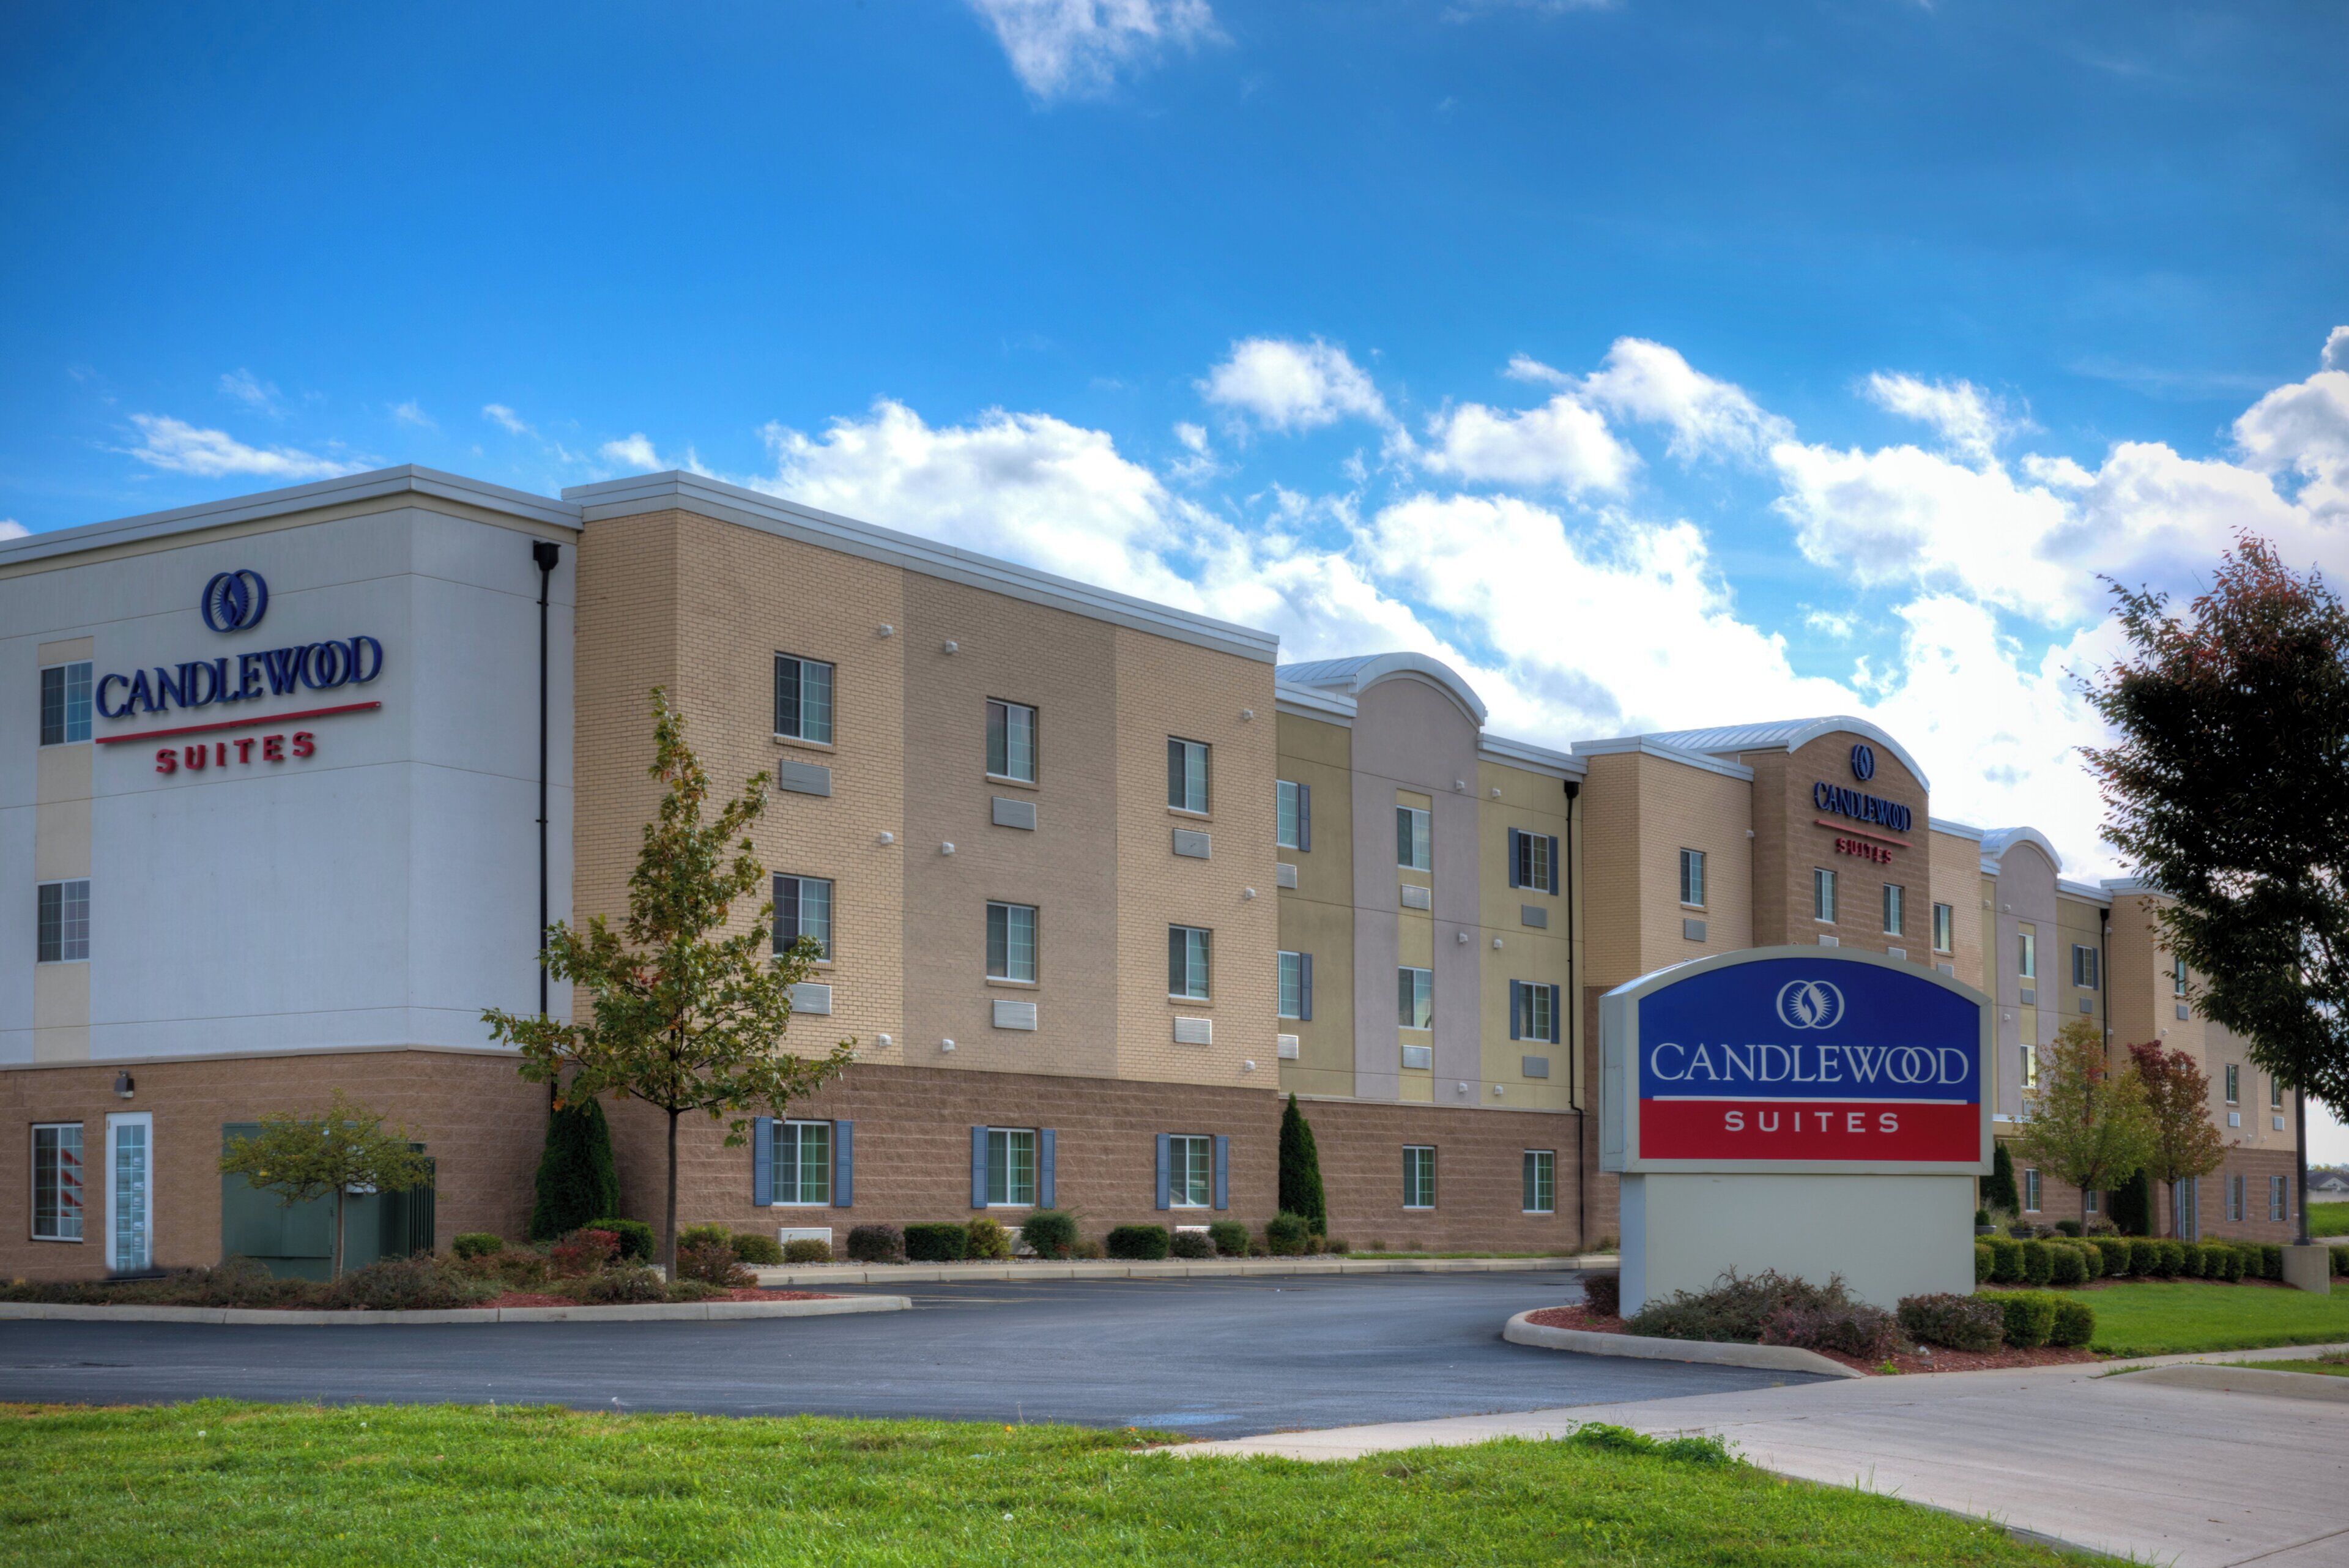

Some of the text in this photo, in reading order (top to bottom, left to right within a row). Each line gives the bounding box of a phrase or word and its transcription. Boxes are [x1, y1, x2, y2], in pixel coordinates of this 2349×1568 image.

[96, 636, 383, 718] CANDLEWOOD
[155, 732, 315, 774] SUITES
[1814, 781, 1912, 832] CANDLEWOOD
[1836, 837, 1893, 864] SUITES
[1651, 1042, 1969, 1084] CANDLEWOOD
[1724, 1110, 1899, 1133] SUITES
